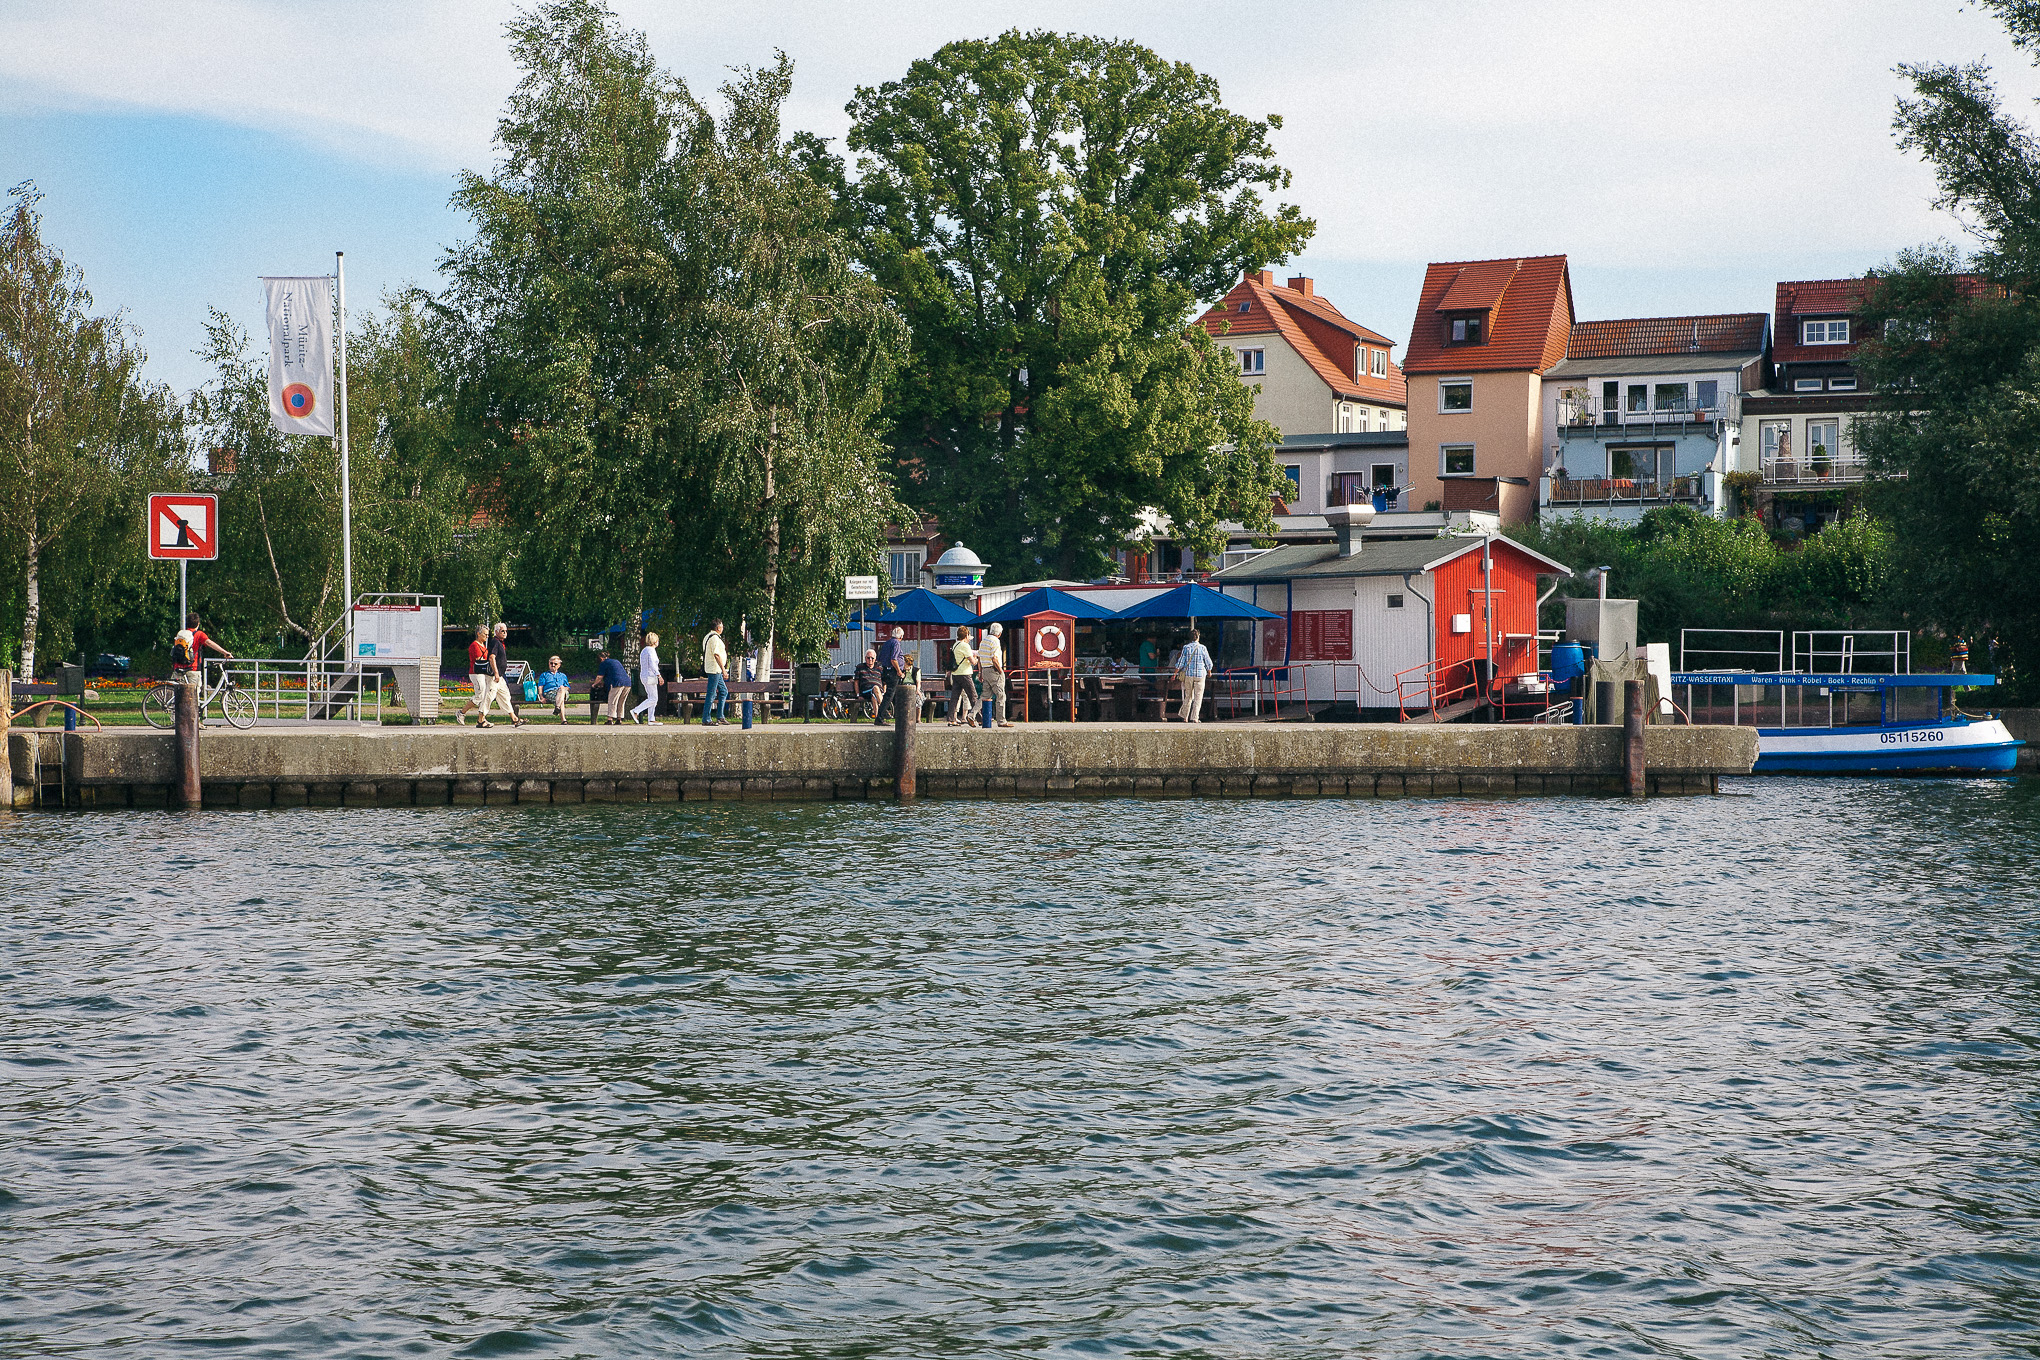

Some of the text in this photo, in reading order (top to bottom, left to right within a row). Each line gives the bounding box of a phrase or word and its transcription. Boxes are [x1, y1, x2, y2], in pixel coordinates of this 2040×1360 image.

[281, 292, 294, 367] Nationalpark
[298, 324, 309, 368] Müritz-
[1751, 676, 1773, 684] Waren
[1778, 676, 1796, 684] Klink
[1802, 676, 1822, 684] Röbel
[1880, 731, 1944, 744] 05115260
